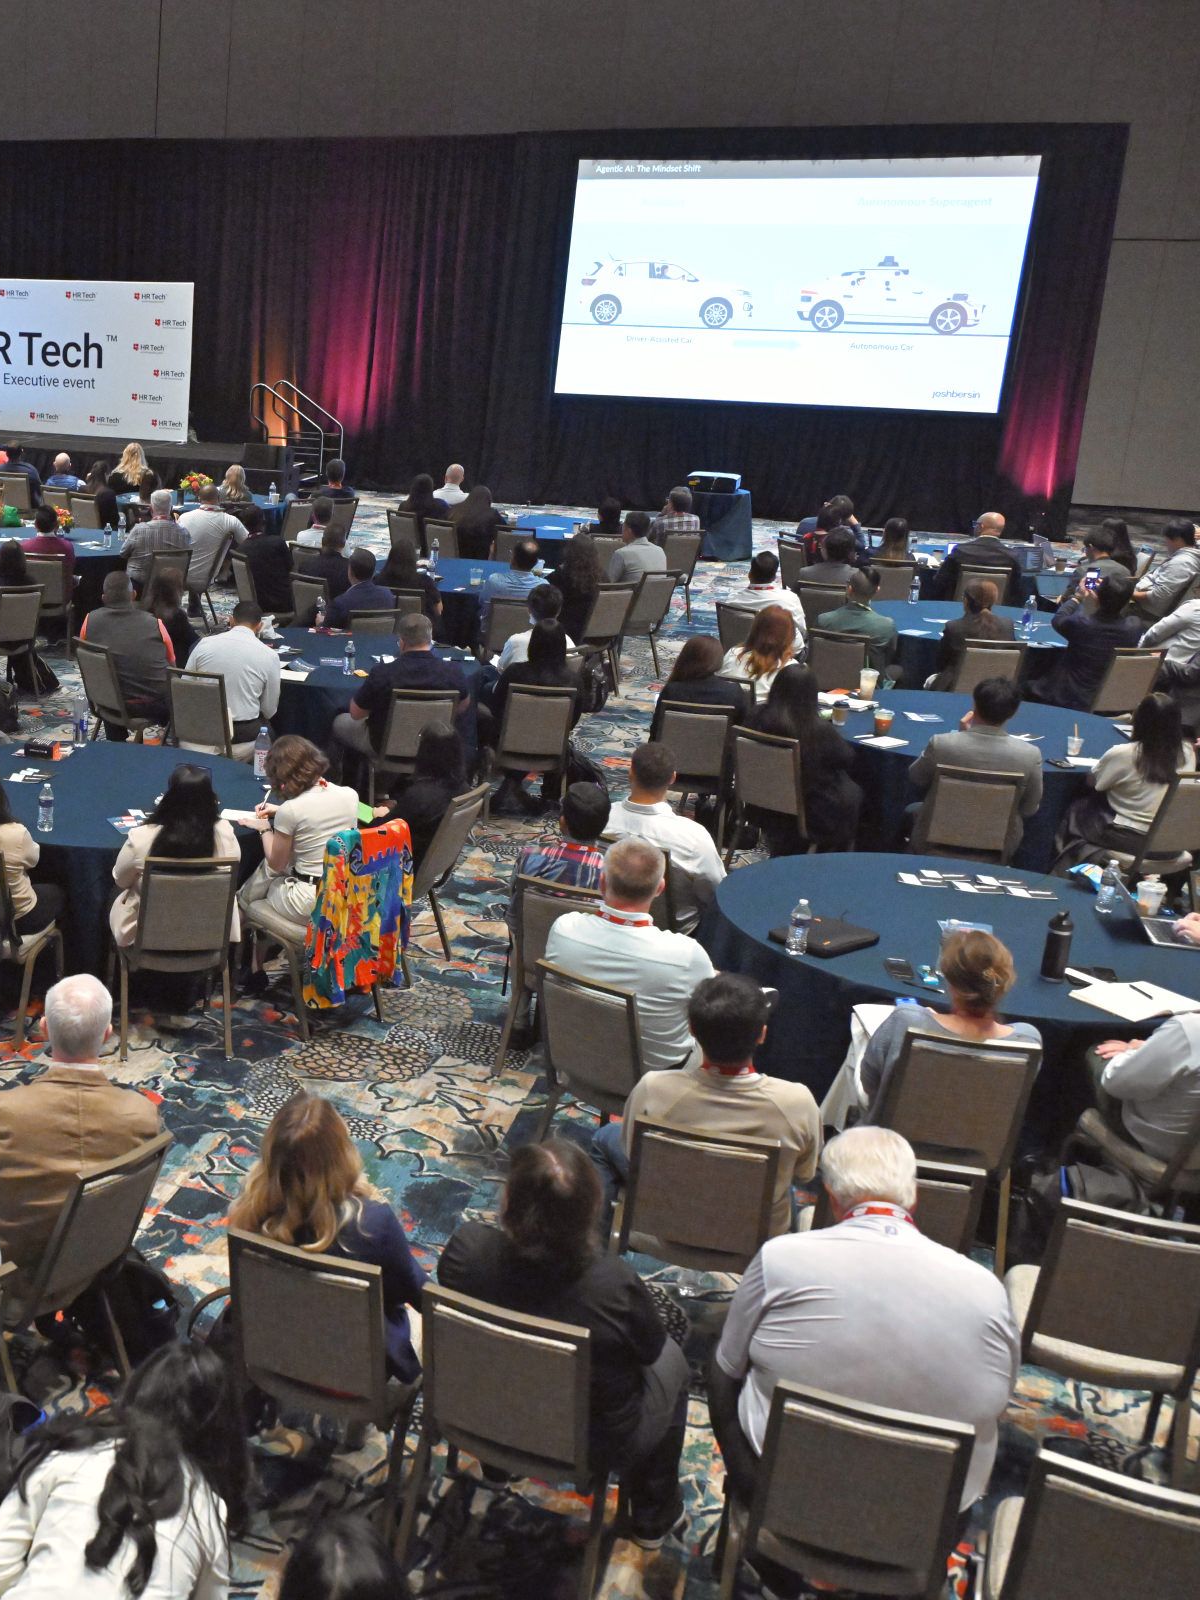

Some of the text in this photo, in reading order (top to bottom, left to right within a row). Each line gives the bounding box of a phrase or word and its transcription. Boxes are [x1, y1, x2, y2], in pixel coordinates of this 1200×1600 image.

[596, 165, 623, 174] Agentic
[637, 165, 650, 173] The
[652, 165, 682, 173] Mindset
[683, 164, 701, 173] Shift
[18, 331, 103, 369] Tech
[170, 370, 185, 378] Tech
[3, 373, 60, 388] Executive
[62, 377, 96, 390] event
[149, 394, 163, 402] Tech
[168, 420, 183, 428] Tech
